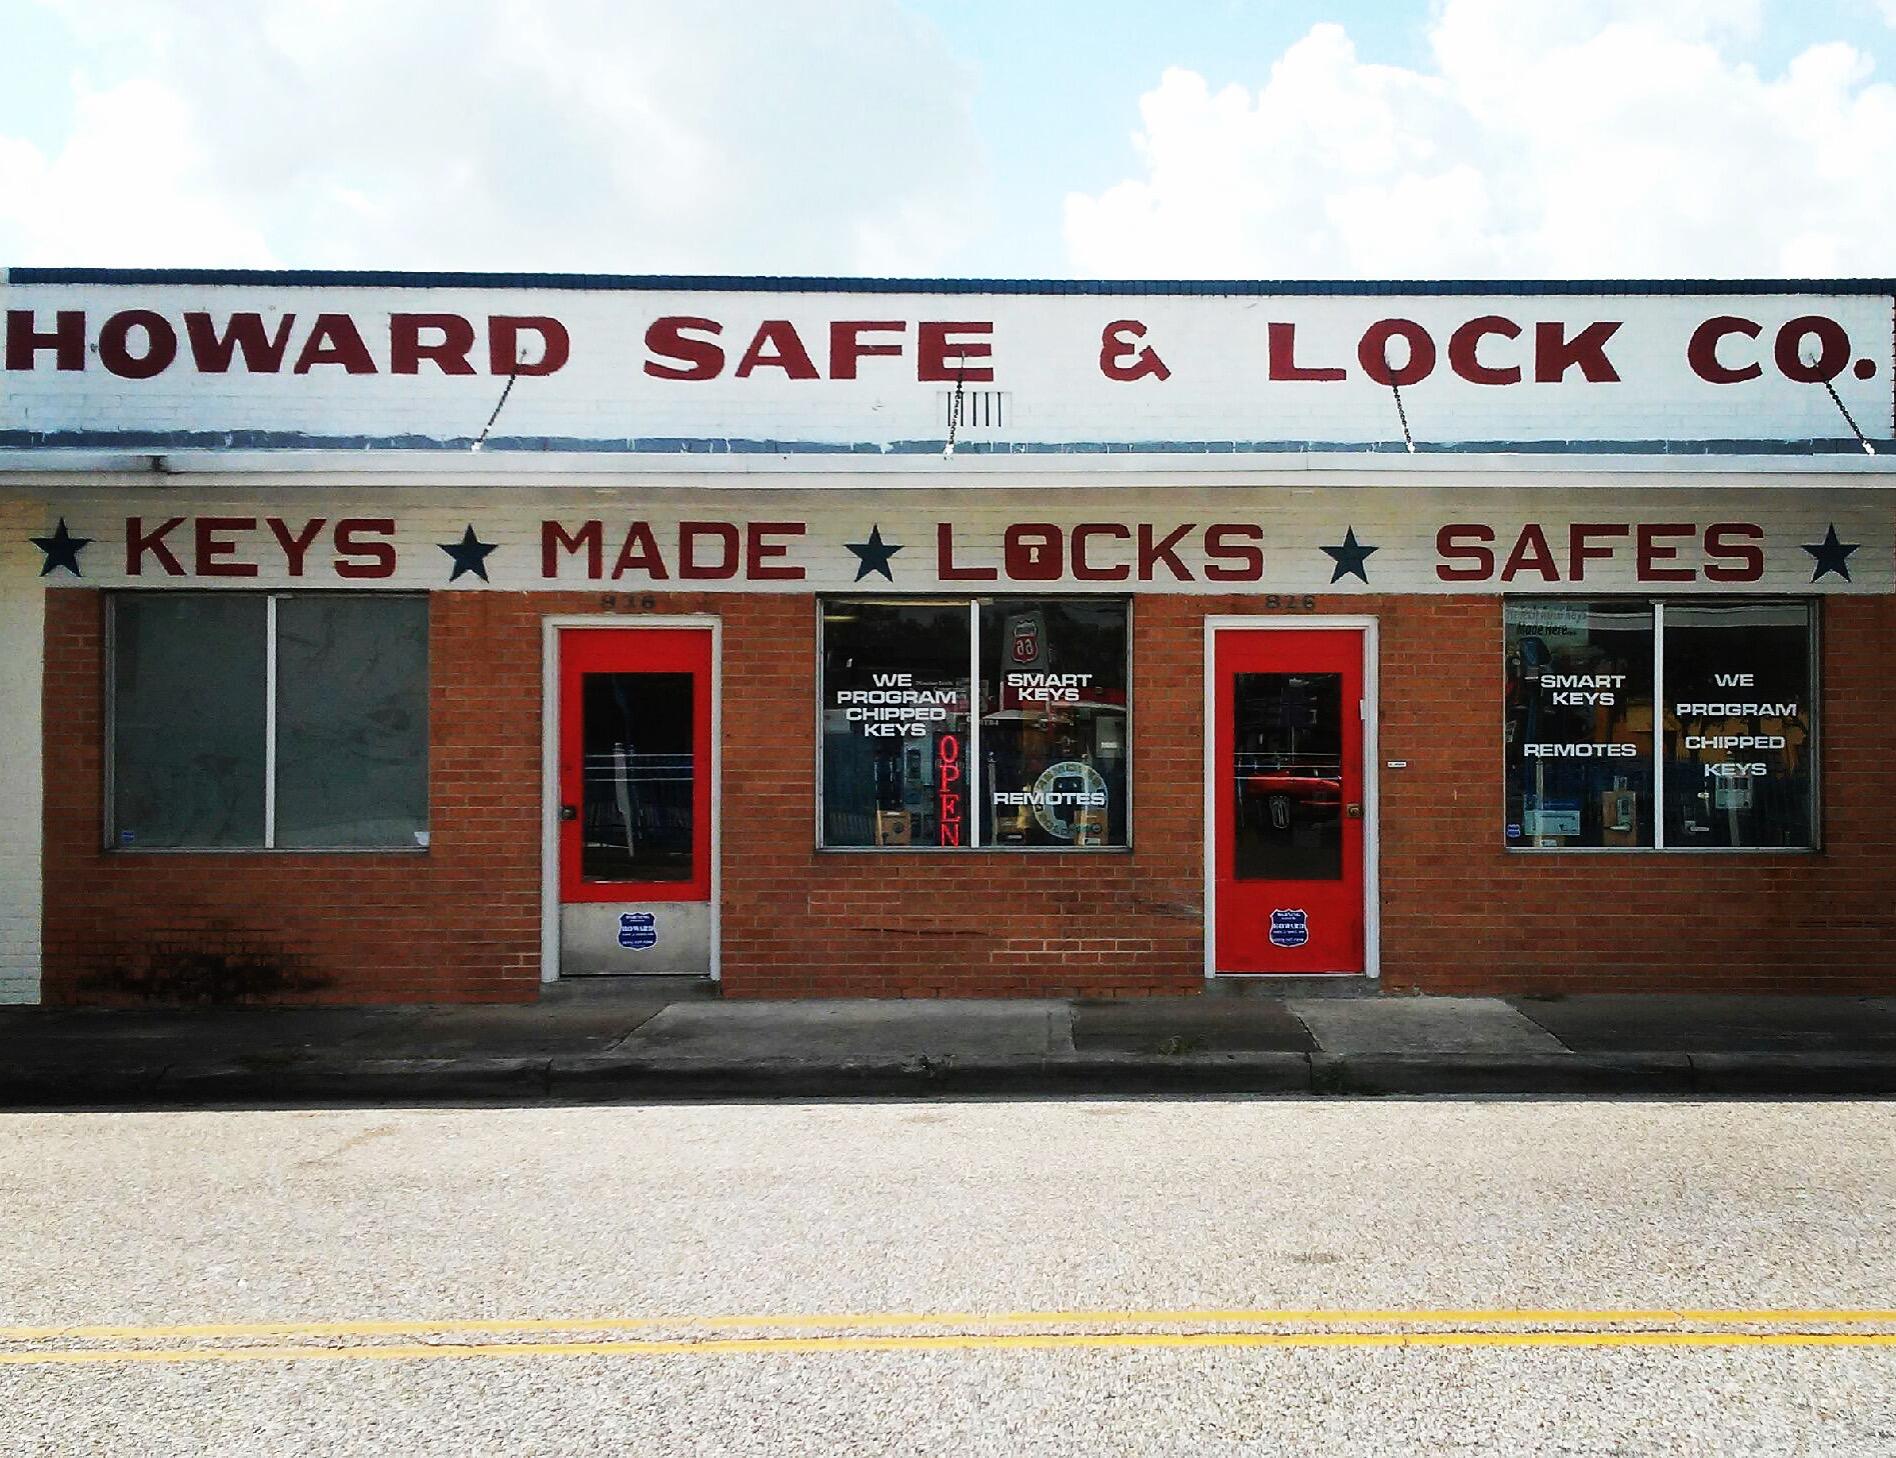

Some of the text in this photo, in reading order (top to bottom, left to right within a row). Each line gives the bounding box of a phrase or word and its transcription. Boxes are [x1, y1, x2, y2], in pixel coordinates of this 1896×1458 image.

[5, 309, 1877, 387] HOWARD SAFE & LOCK CO.
[126, 515, 1764, 582] KEYS MADE LOCKS SAFES
[872, 674, 912, 687] WE
[1007, 674, 1093, 687] SMART
[1540, 675, 1626, 688] SMART
[1714, 674, 1754, 687] WE
[837, 691, 957, 704] PROGRAM
[1018, 688, 1080, 701] KEYS
[1552, 692, 1615, 706] KEYS
[845, 708, 947, 721] CHIPPED
[1676, 703, 1797, 716] PROGRAM
[864, 723, 927, 737] KEYS
[1685, 736, 1786, 749] CHIPPED
[1523, 743, 1637, 757] REMOTES
[1704, 763, 1768, 777] KEYS
[940, 735, 960, 847] OPEN
[993, 792, 1105, 806] REMOTES
